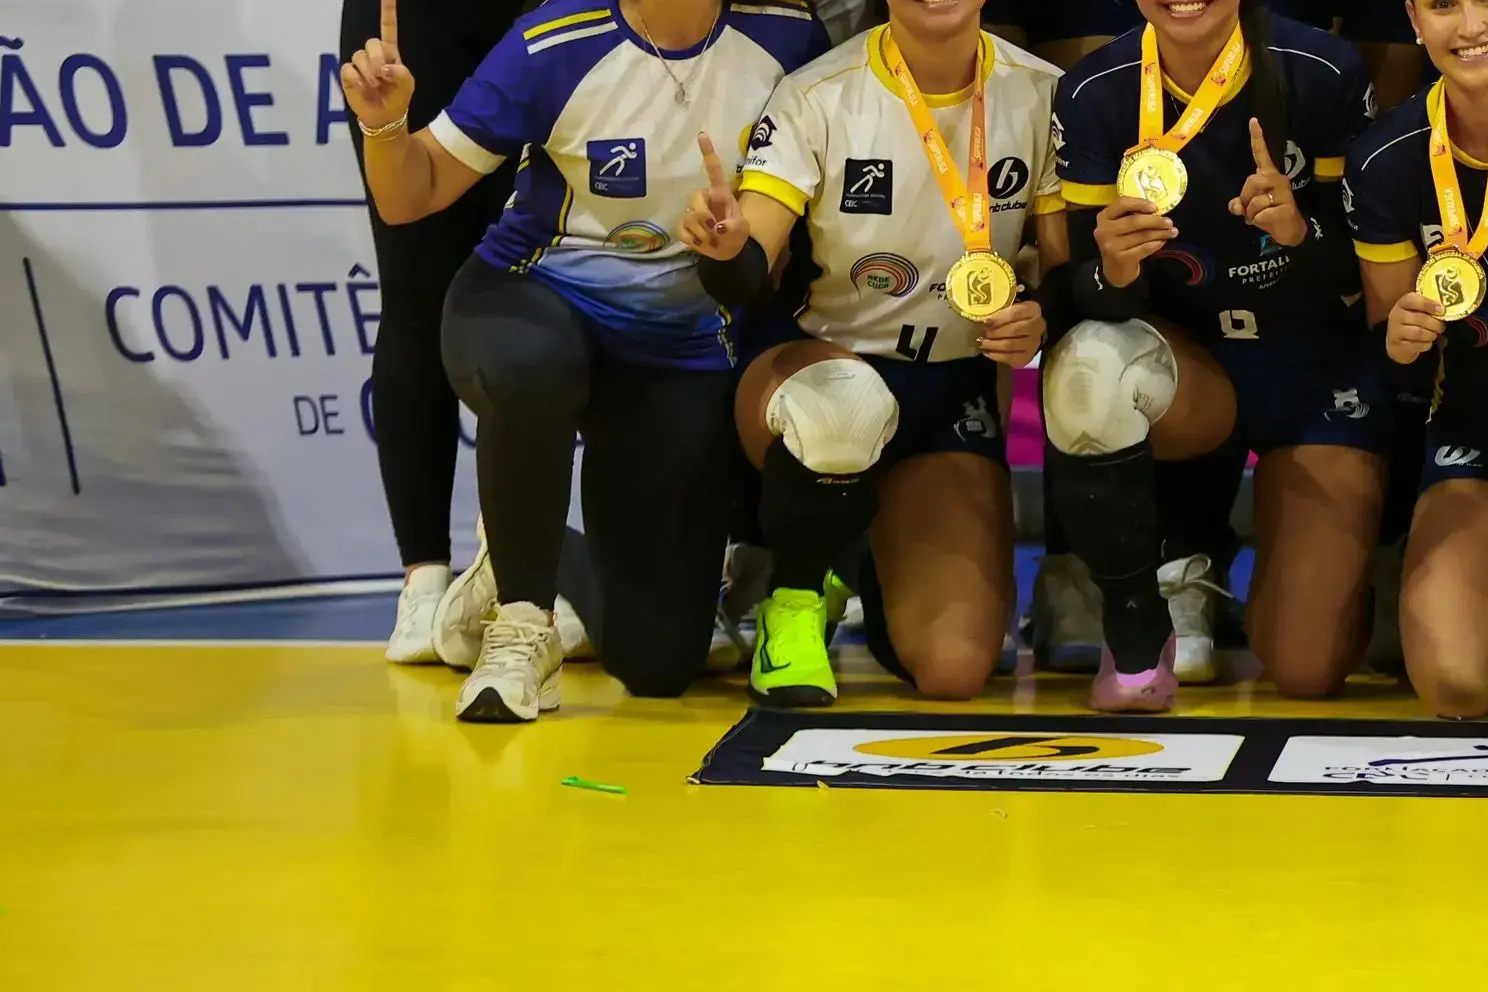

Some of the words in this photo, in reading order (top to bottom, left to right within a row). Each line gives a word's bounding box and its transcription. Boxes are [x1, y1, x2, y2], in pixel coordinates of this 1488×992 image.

[152, 54, 289, 146] DE
[105, 263, 382, 362] COMITÊ
[293, 395, 345, 436] DE
